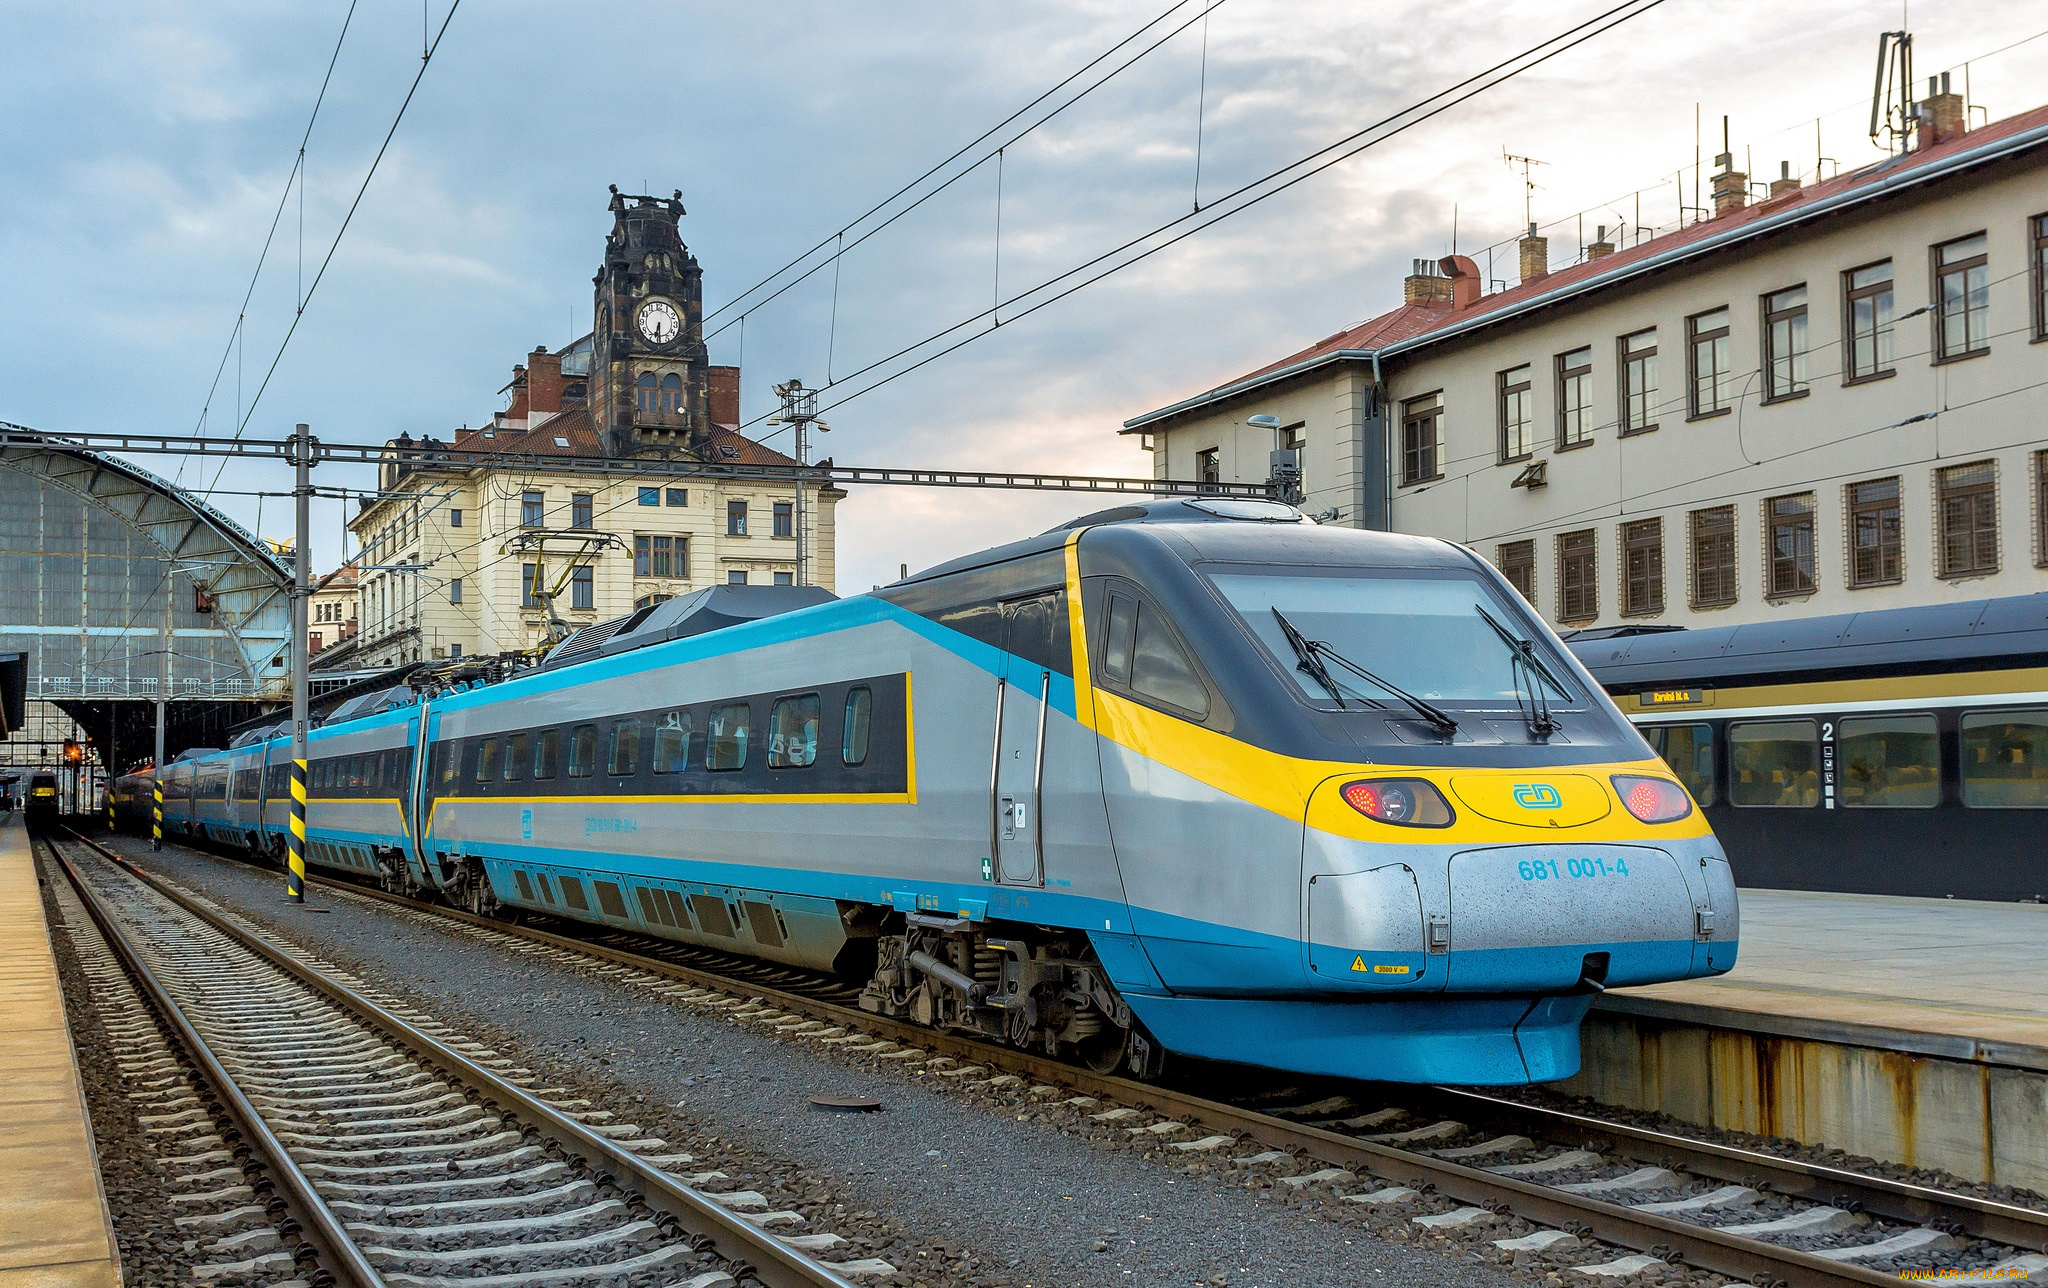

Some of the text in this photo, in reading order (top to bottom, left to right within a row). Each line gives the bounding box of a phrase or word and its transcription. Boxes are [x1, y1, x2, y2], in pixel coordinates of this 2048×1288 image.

[1822, 722, 1833, 741] 2
[1518, 857, 1629, 881] 681 001-4
